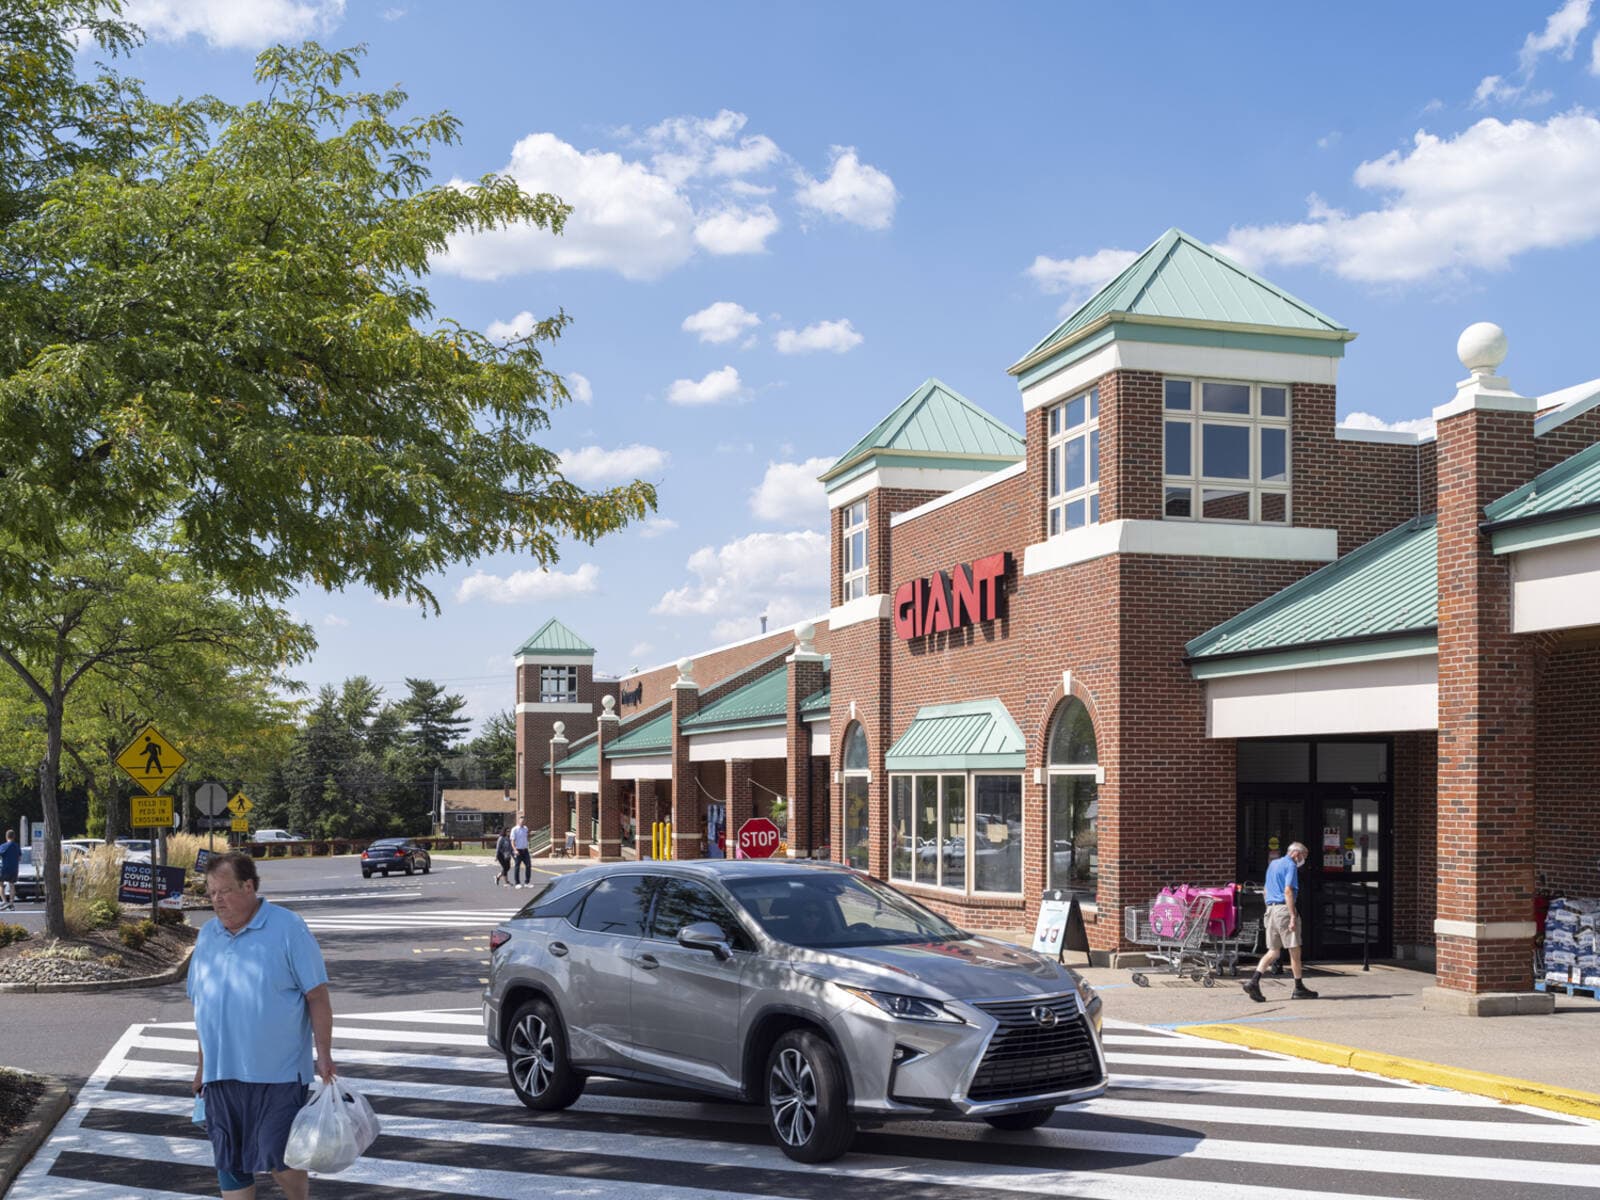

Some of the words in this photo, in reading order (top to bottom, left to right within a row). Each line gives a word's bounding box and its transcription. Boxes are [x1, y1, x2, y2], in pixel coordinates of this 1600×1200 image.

[894, 552, 1008, 640] GIANT
[135, 816, 170, 824] CROSSWALK
[741, 831, 777, 847] STOP
[125, 865, 138, 873] NO
[139, 866, 161, 875] COT
[140, 881, 167, 890] SHTS
